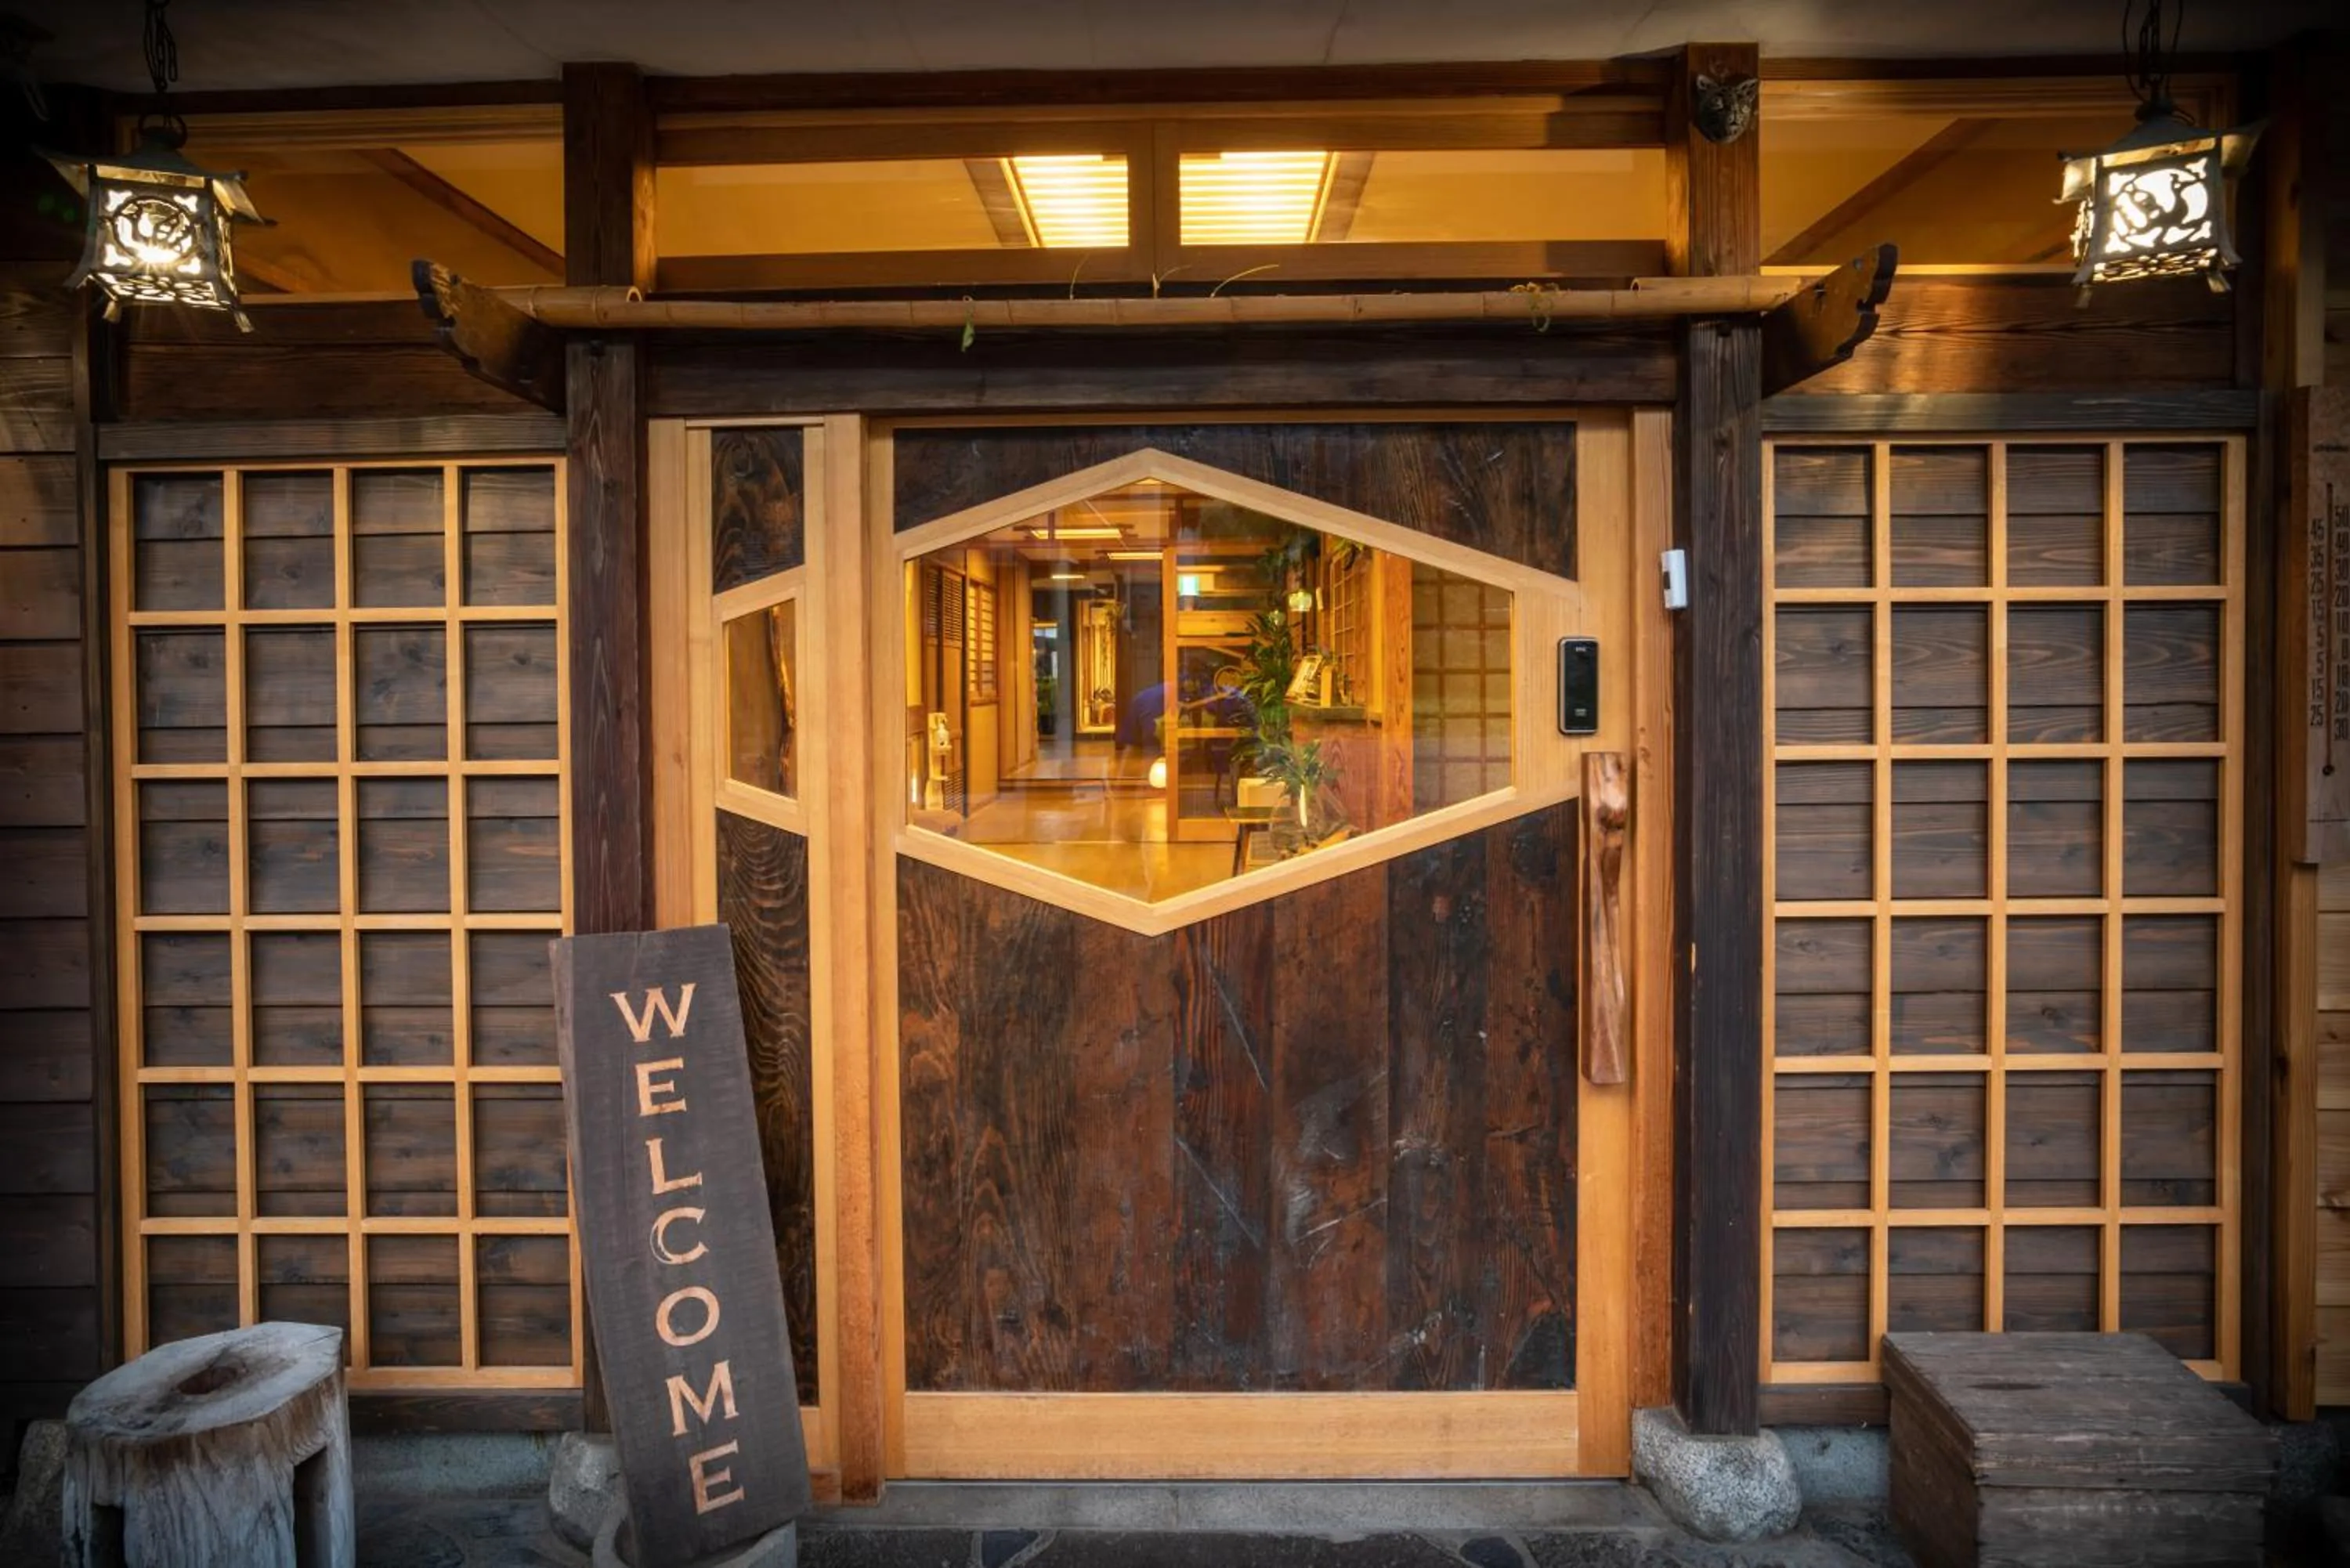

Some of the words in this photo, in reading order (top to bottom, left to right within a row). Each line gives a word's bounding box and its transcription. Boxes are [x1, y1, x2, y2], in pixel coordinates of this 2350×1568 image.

[2335, 504, 2349, 526] 50
[2311, 518, 2324, 540] 45
[2336, 533, 2349, 555] 40
[2311, 545, 2324, 567] 35
[2335, 558, 2349, 580] 30
[2311, 572, 2324, 594] 25
[2335, 585, 2349, 606] 20
[2312, 599, 2324, 621] 15
[2337, 612, 2349, 634] 10
[2316, 625, 2324, 647] 5
[2342, 638, 2349, 659] 0
[2316, 652, 2324, 674] 5
[2312, 677, 2324, 699] 15
[2335, 690, 2349, 714] 20
[2310, 704, 2323, 726] 25
[2334, 718, 2348, 741] 30
[609, 982, 745, 1516] WELCOME
